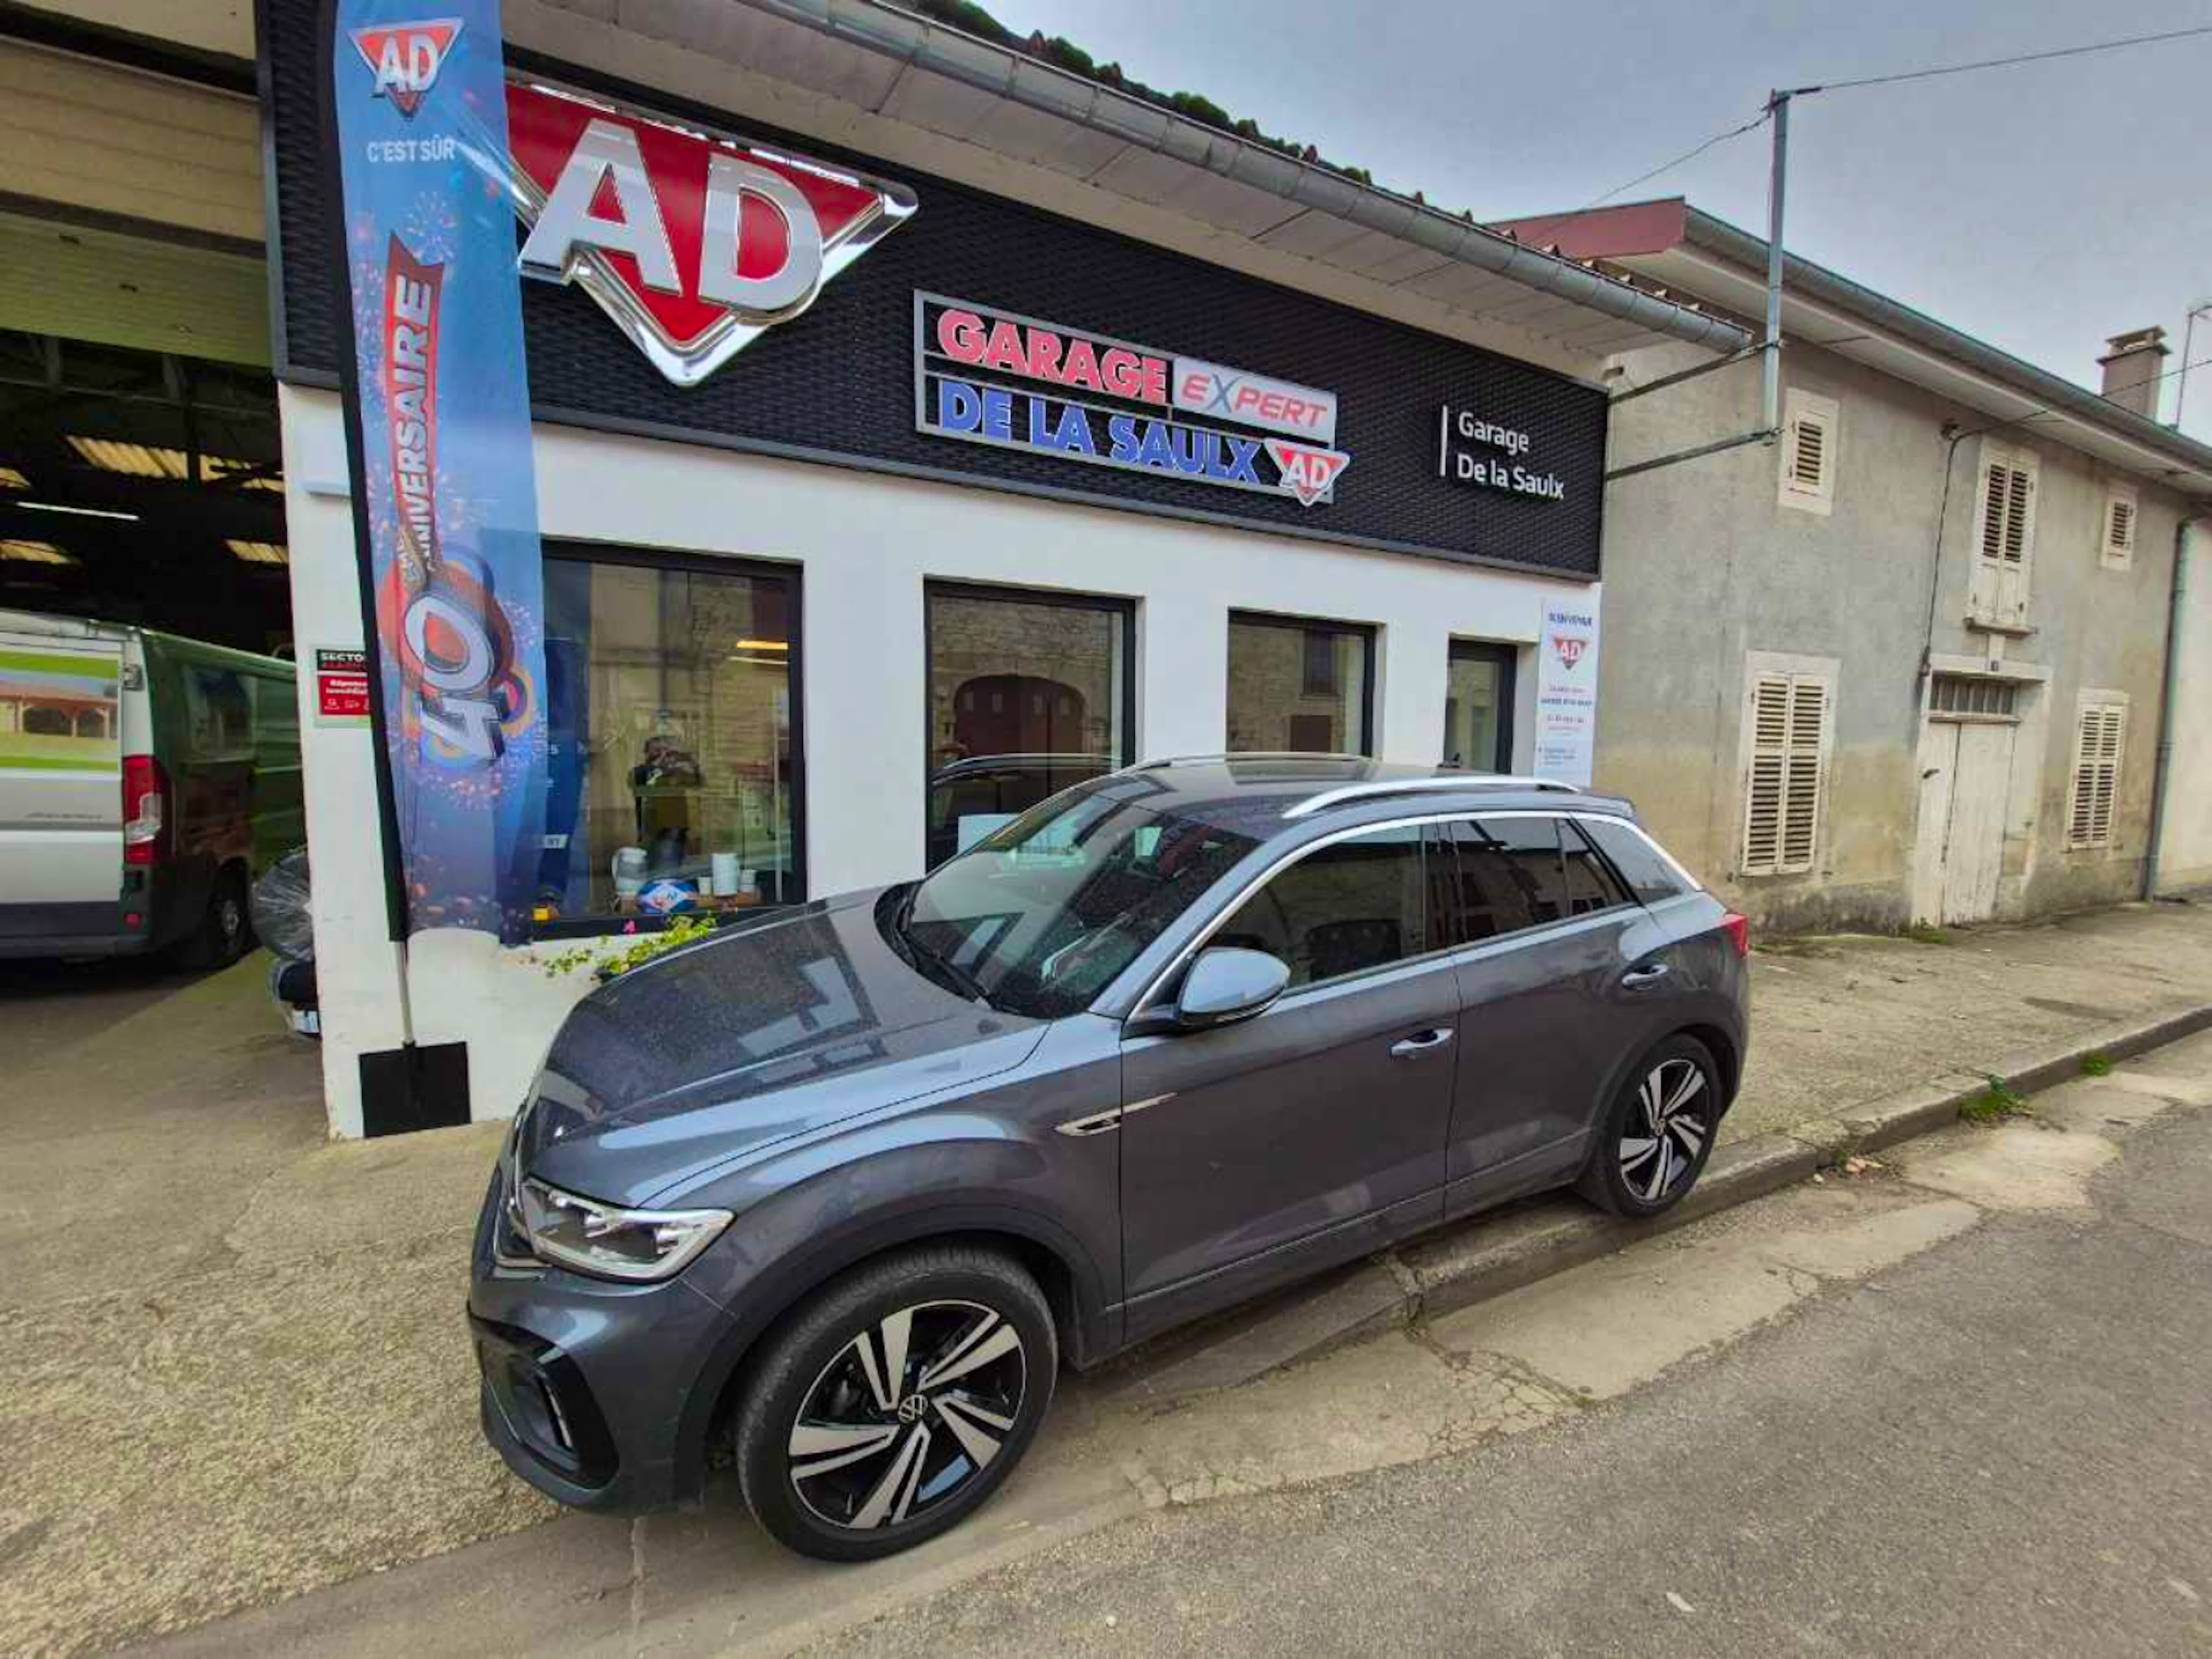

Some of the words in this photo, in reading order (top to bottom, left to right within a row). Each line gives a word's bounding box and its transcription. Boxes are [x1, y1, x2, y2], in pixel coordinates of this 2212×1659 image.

[375, 33, 439, 94] AD
[366, 139, 418, 163] C'EST
[419, 134, 455, 162] SÛR
[519, 117, 824, 324] AD
[937, 308, 1167, 405] GARAGE
[940, 378, 1012, 444] DE
[1029, 396, 1096, 459] LA
[1108, 414, 1262, 486] SAULX
[1459, 411, 1529, 456] Garage
[1280, 457, 1330, 489] AD
[1457, 453, 1487, 483] De
[1490, 459, 1509, 488] la
[1512, 465, 1565, 500] Saulx
[320, 652, 366, 663] SECTO
